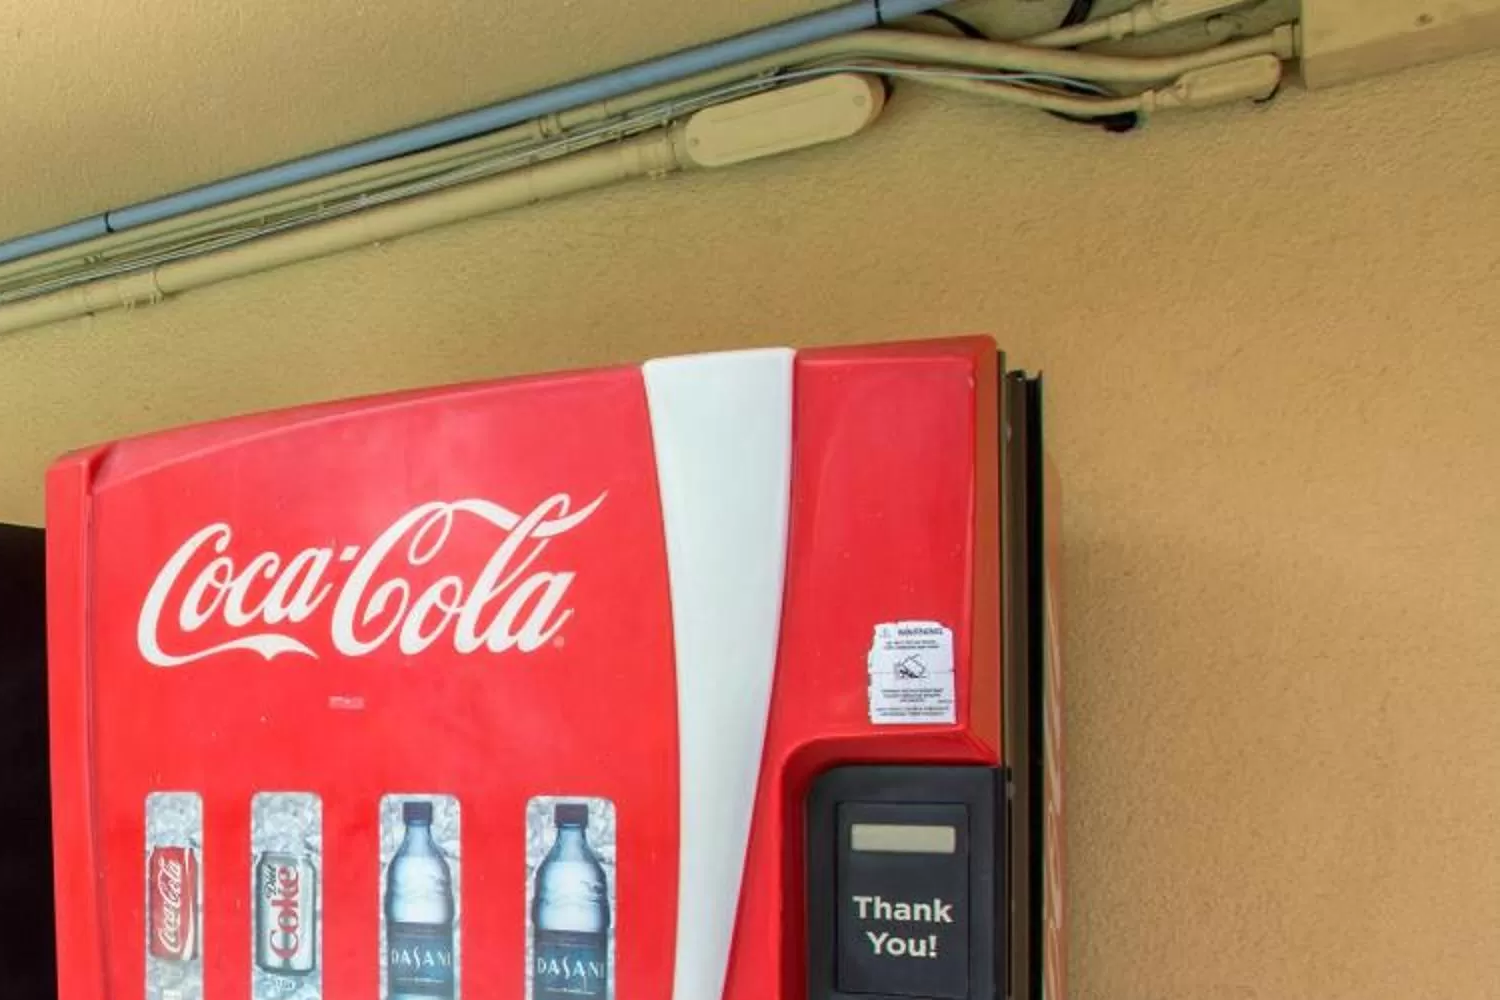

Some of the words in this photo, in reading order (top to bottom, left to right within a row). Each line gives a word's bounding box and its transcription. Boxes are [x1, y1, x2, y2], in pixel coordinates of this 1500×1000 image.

[137, 490, 609, 667] Coca-Cola
[269, 865, 299, 960] Coke
[852, 895, 954, 923] Thank
[866, 931, 937, 958] You!
[391, 946, 451, 971] DASANI
[537, 956, 605, 980] DASANI
